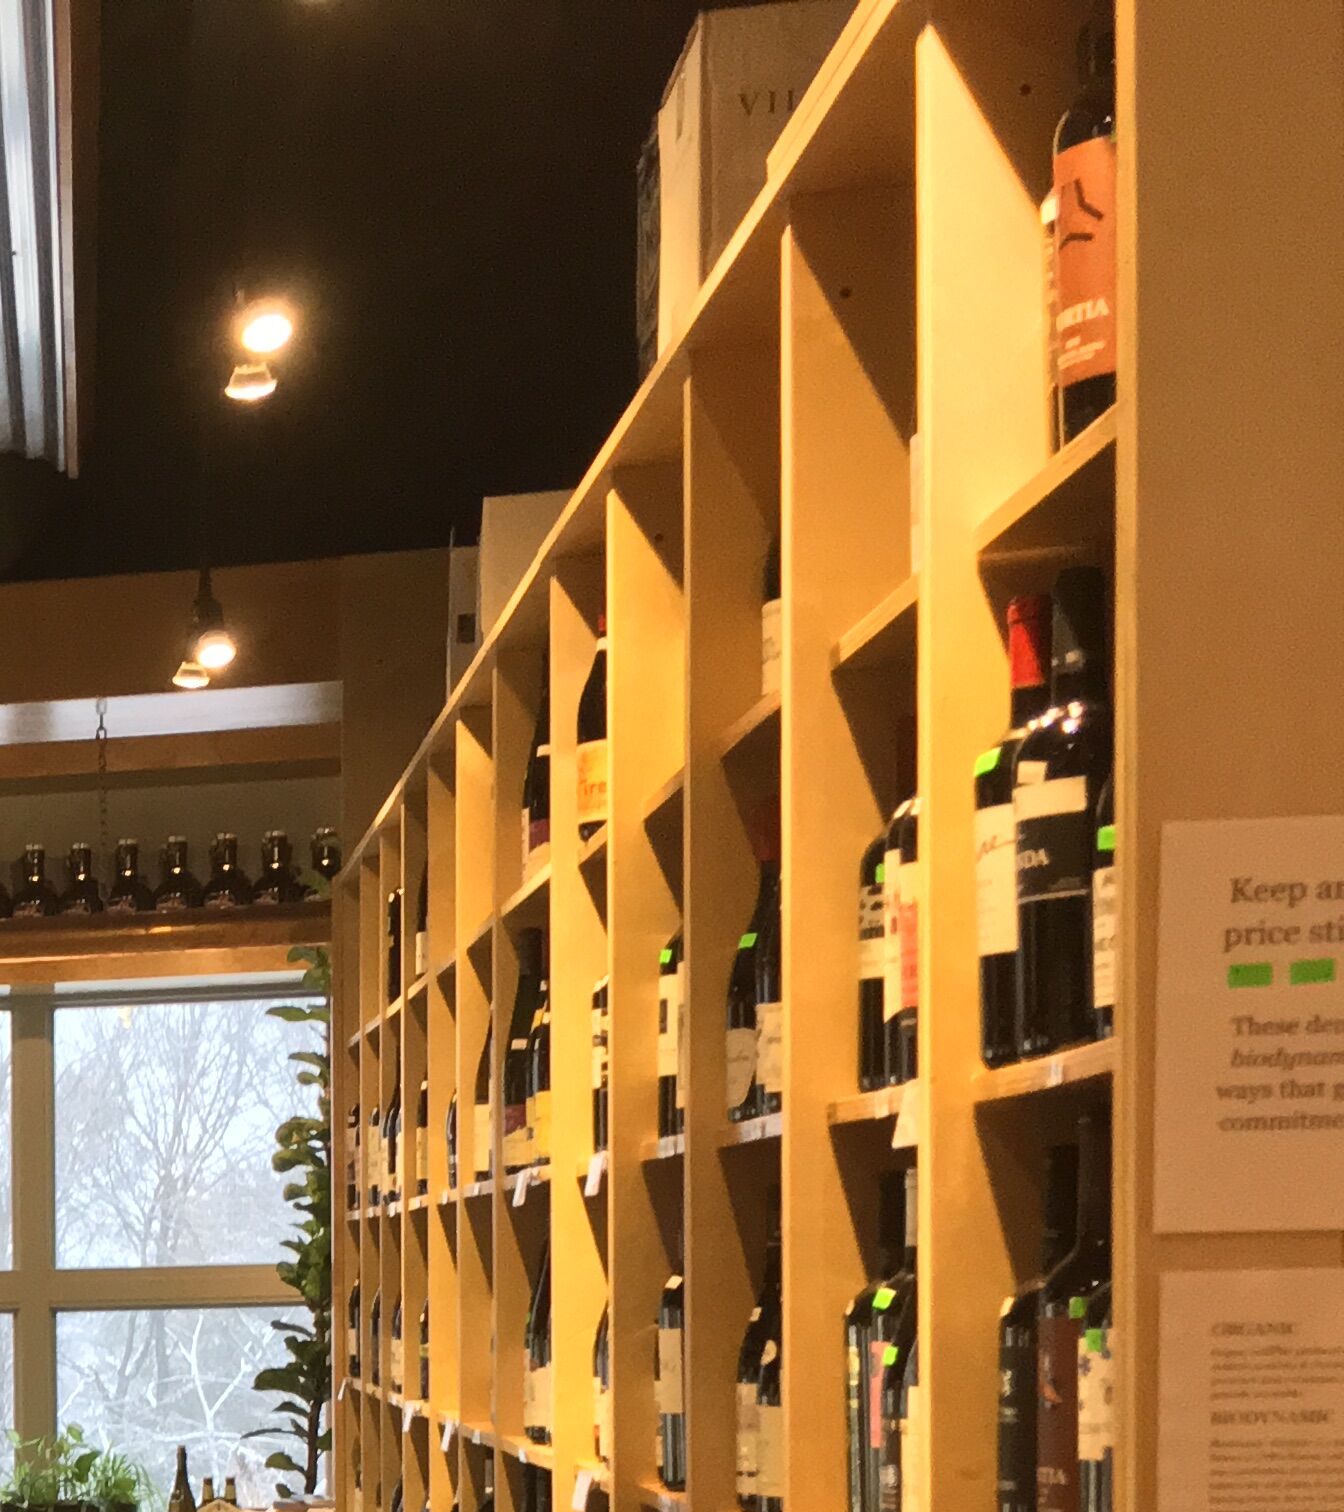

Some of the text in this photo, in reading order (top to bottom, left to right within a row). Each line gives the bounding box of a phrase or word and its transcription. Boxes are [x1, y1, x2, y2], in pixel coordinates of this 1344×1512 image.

[1229, 876, 1308, 909] Keep
[1223, 919, 1302, 953] price
[1230, 1014, 1300, 1037] These
[1279, 1078, 1326, 1100] that
